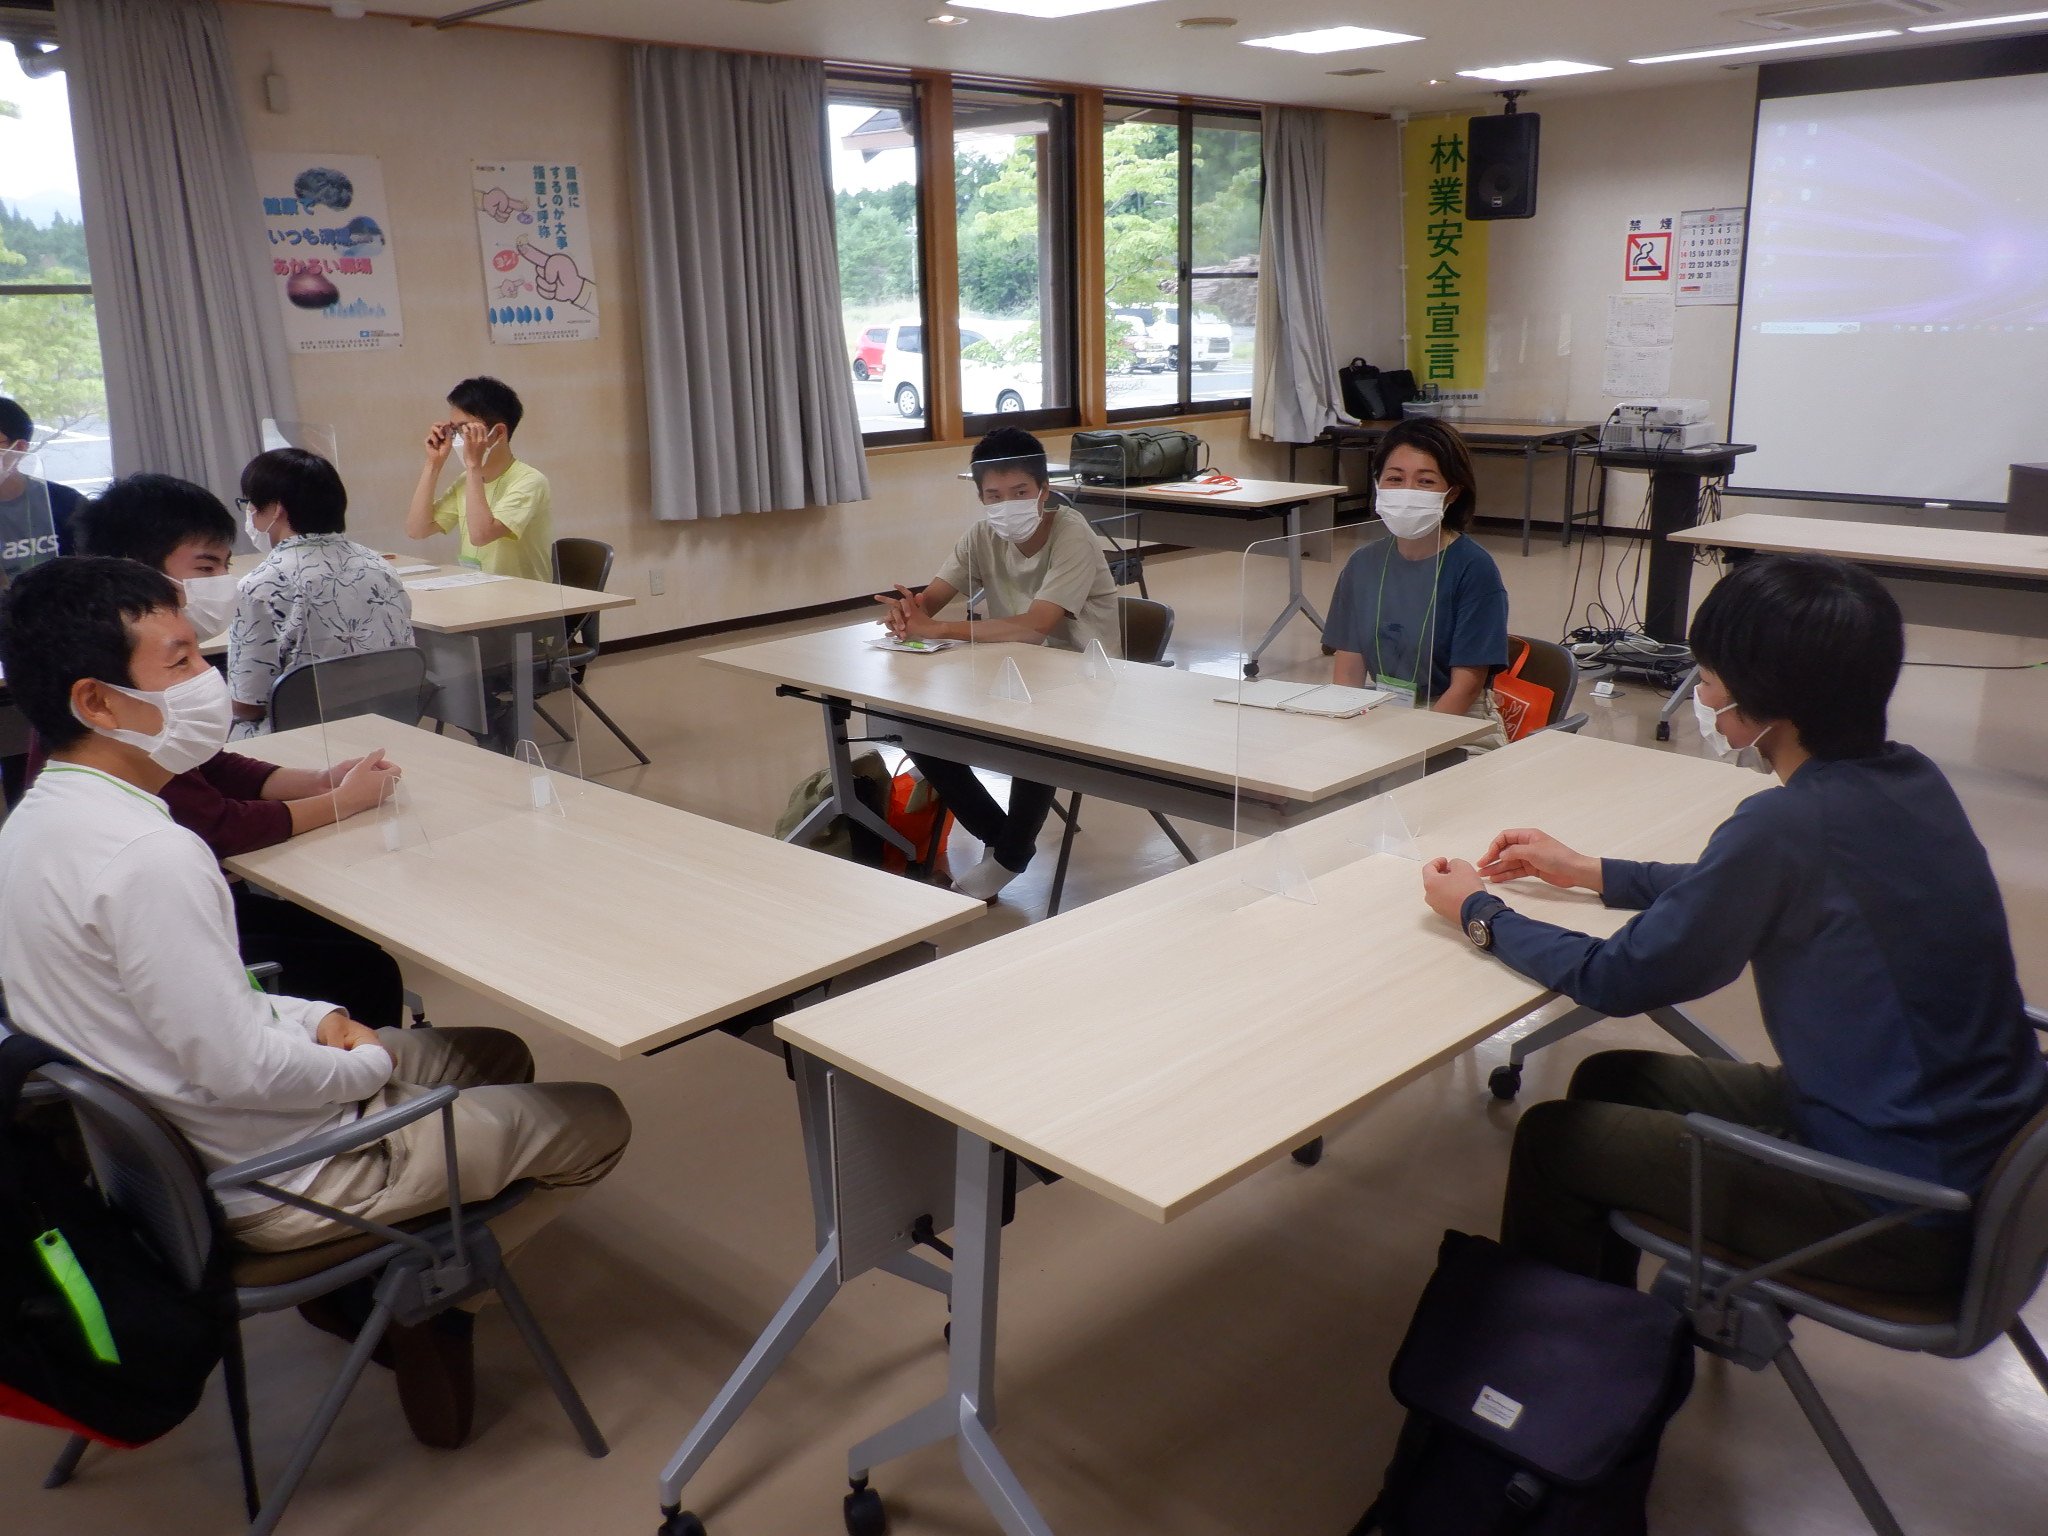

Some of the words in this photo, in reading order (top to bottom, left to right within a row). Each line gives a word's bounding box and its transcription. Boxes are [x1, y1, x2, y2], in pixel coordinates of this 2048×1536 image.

[1425, 133, 1466, 380] 林業安全宣言
[2, 534, 59, 560] asics
